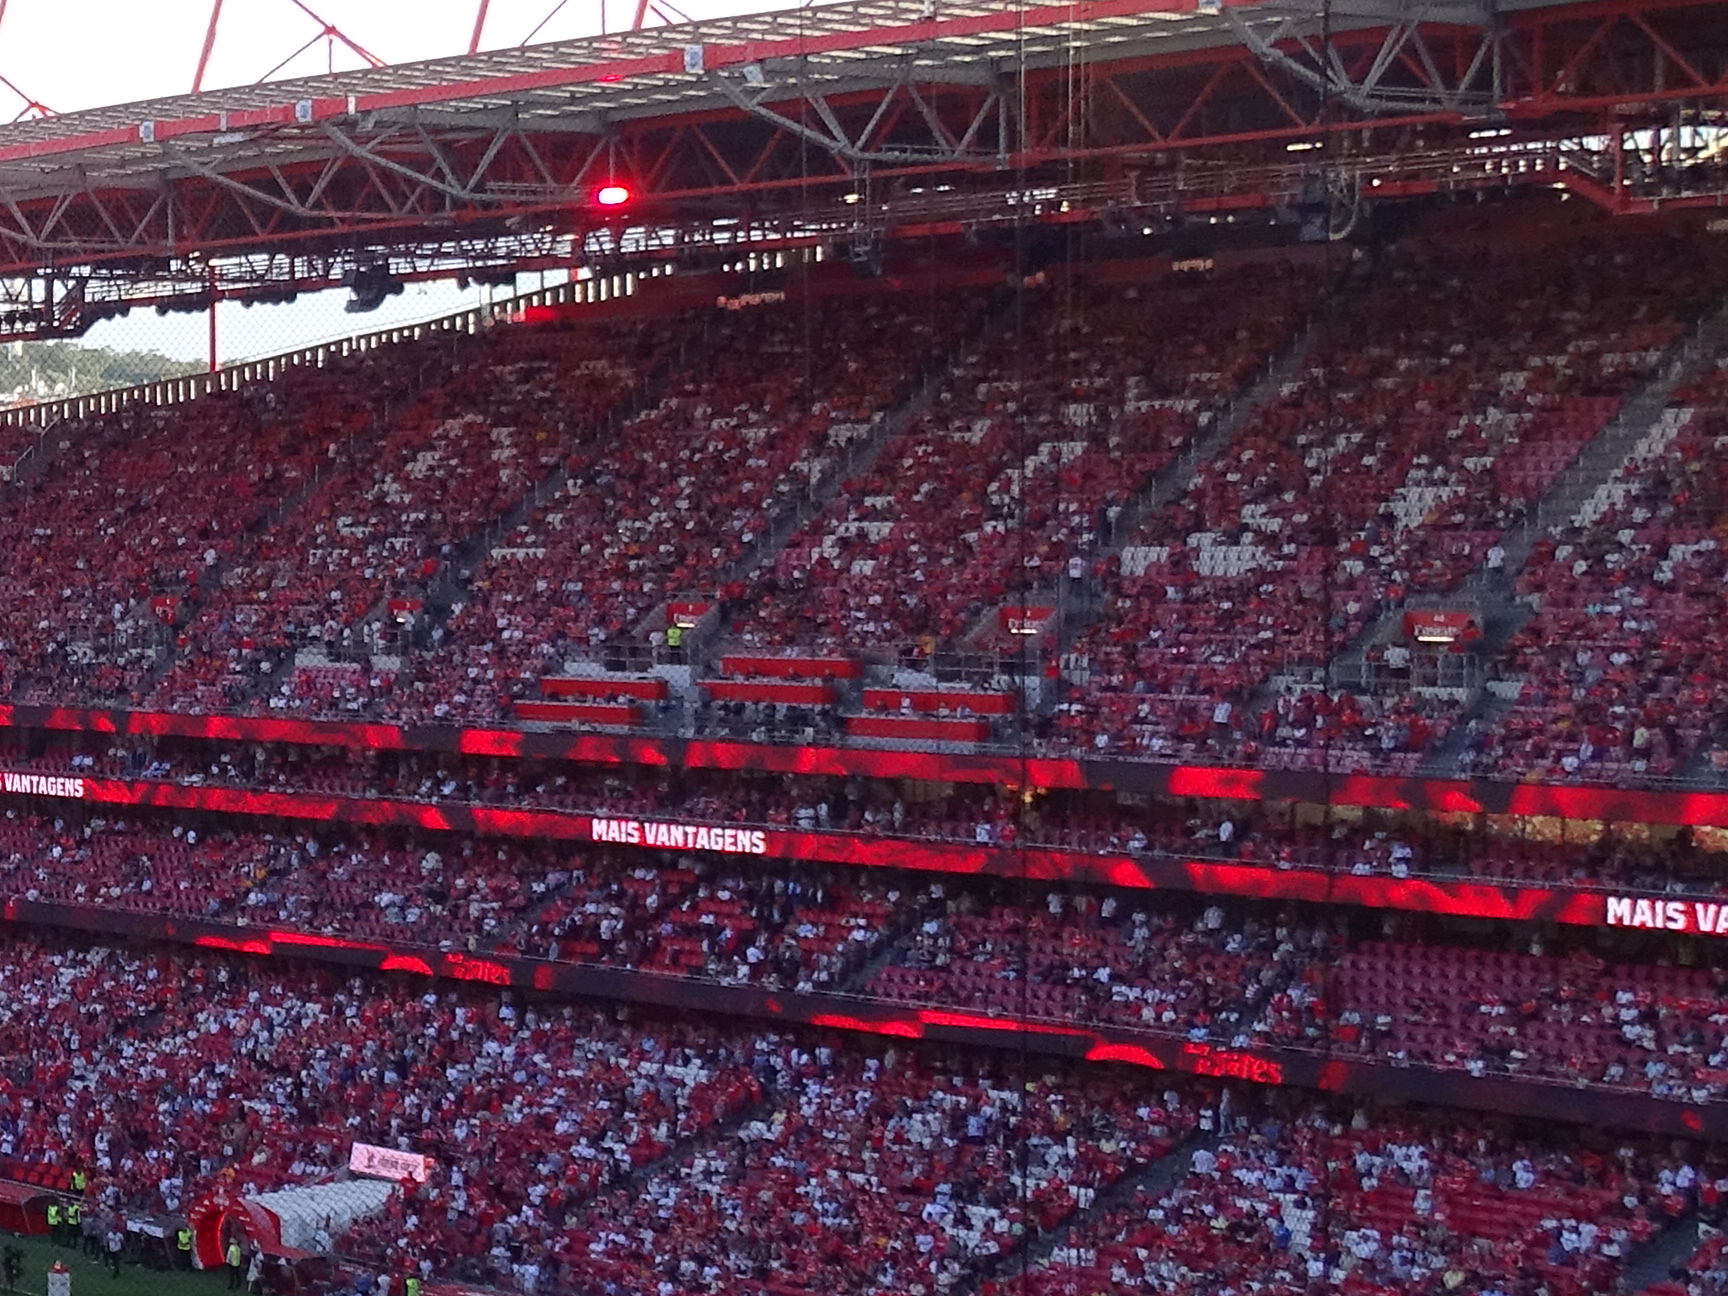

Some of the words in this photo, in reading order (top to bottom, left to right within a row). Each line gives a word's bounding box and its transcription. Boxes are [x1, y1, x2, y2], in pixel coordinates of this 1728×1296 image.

[4, 773, 84, 798] VANTAGENS
[592, 818, 641, 844] MAIS
[644, 822, 766, 854] VANTAGENS
[1606, 896, 1688, 931] MAIS
